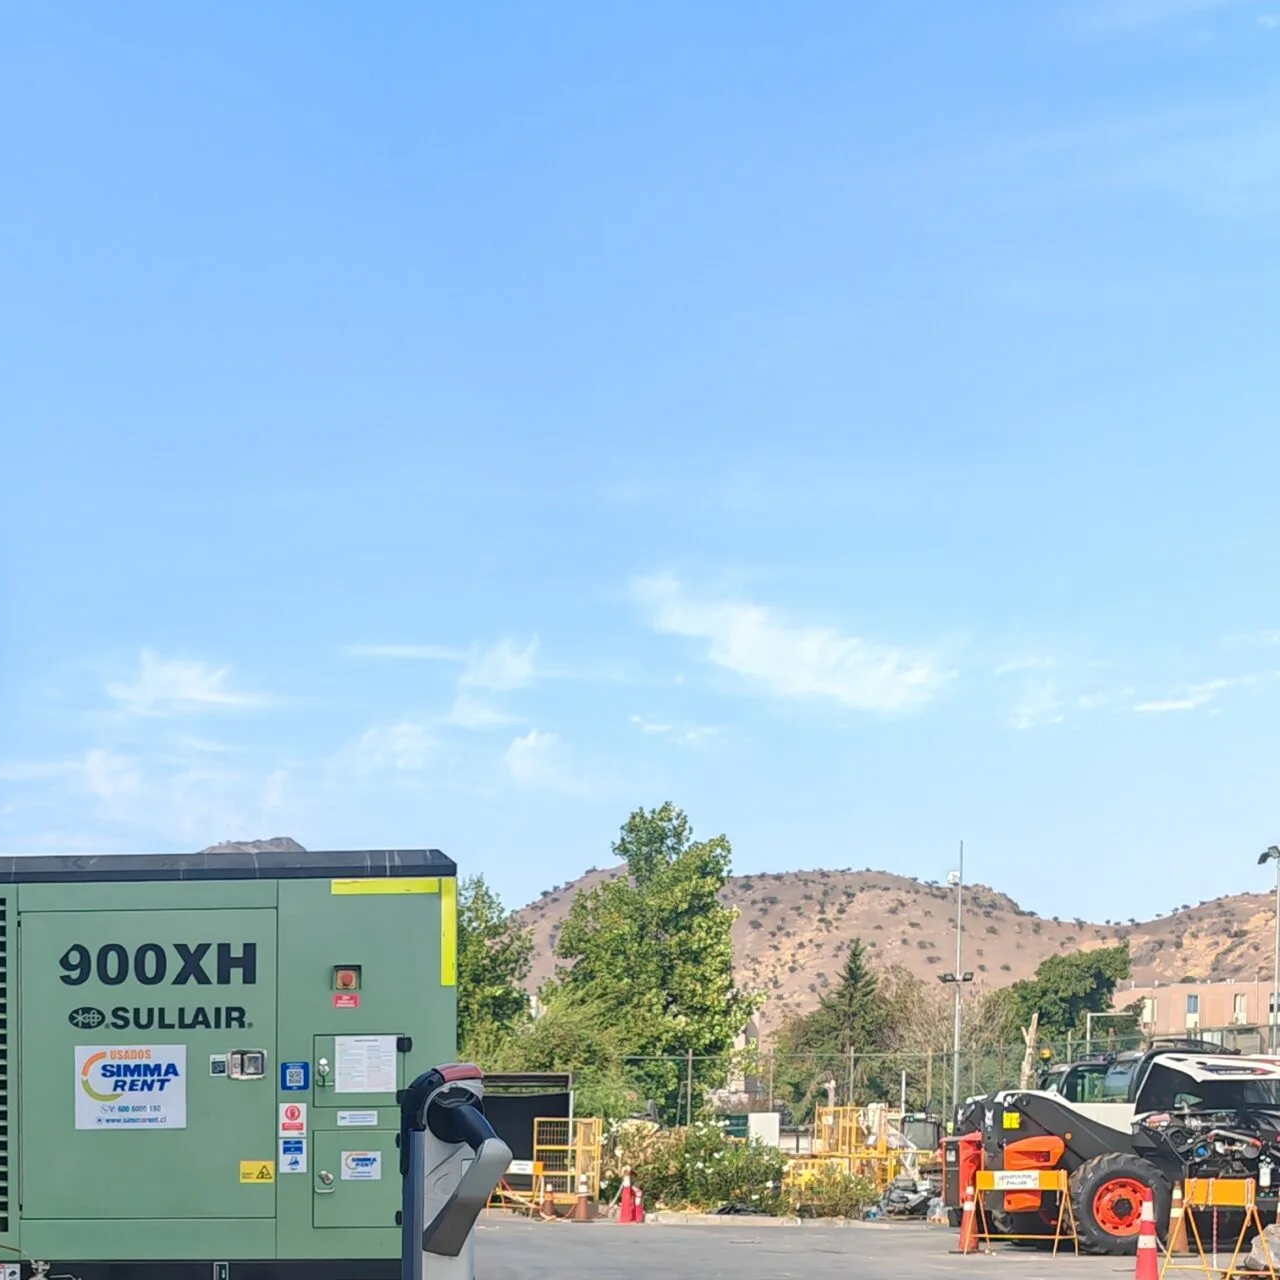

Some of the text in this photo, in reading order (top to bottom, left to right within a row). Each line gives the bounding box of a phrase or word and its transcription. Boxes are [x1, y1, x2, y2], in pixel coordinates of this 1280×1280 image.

[59, 943, 257, 986] 900XH
[111, 1007, 247, 1030] SULLAIR
[110, 1049, 152, 1060] USADOS
[101, 1063, 180, 1078] SIMMA
[112, 1079, 172, 1092] RENT
